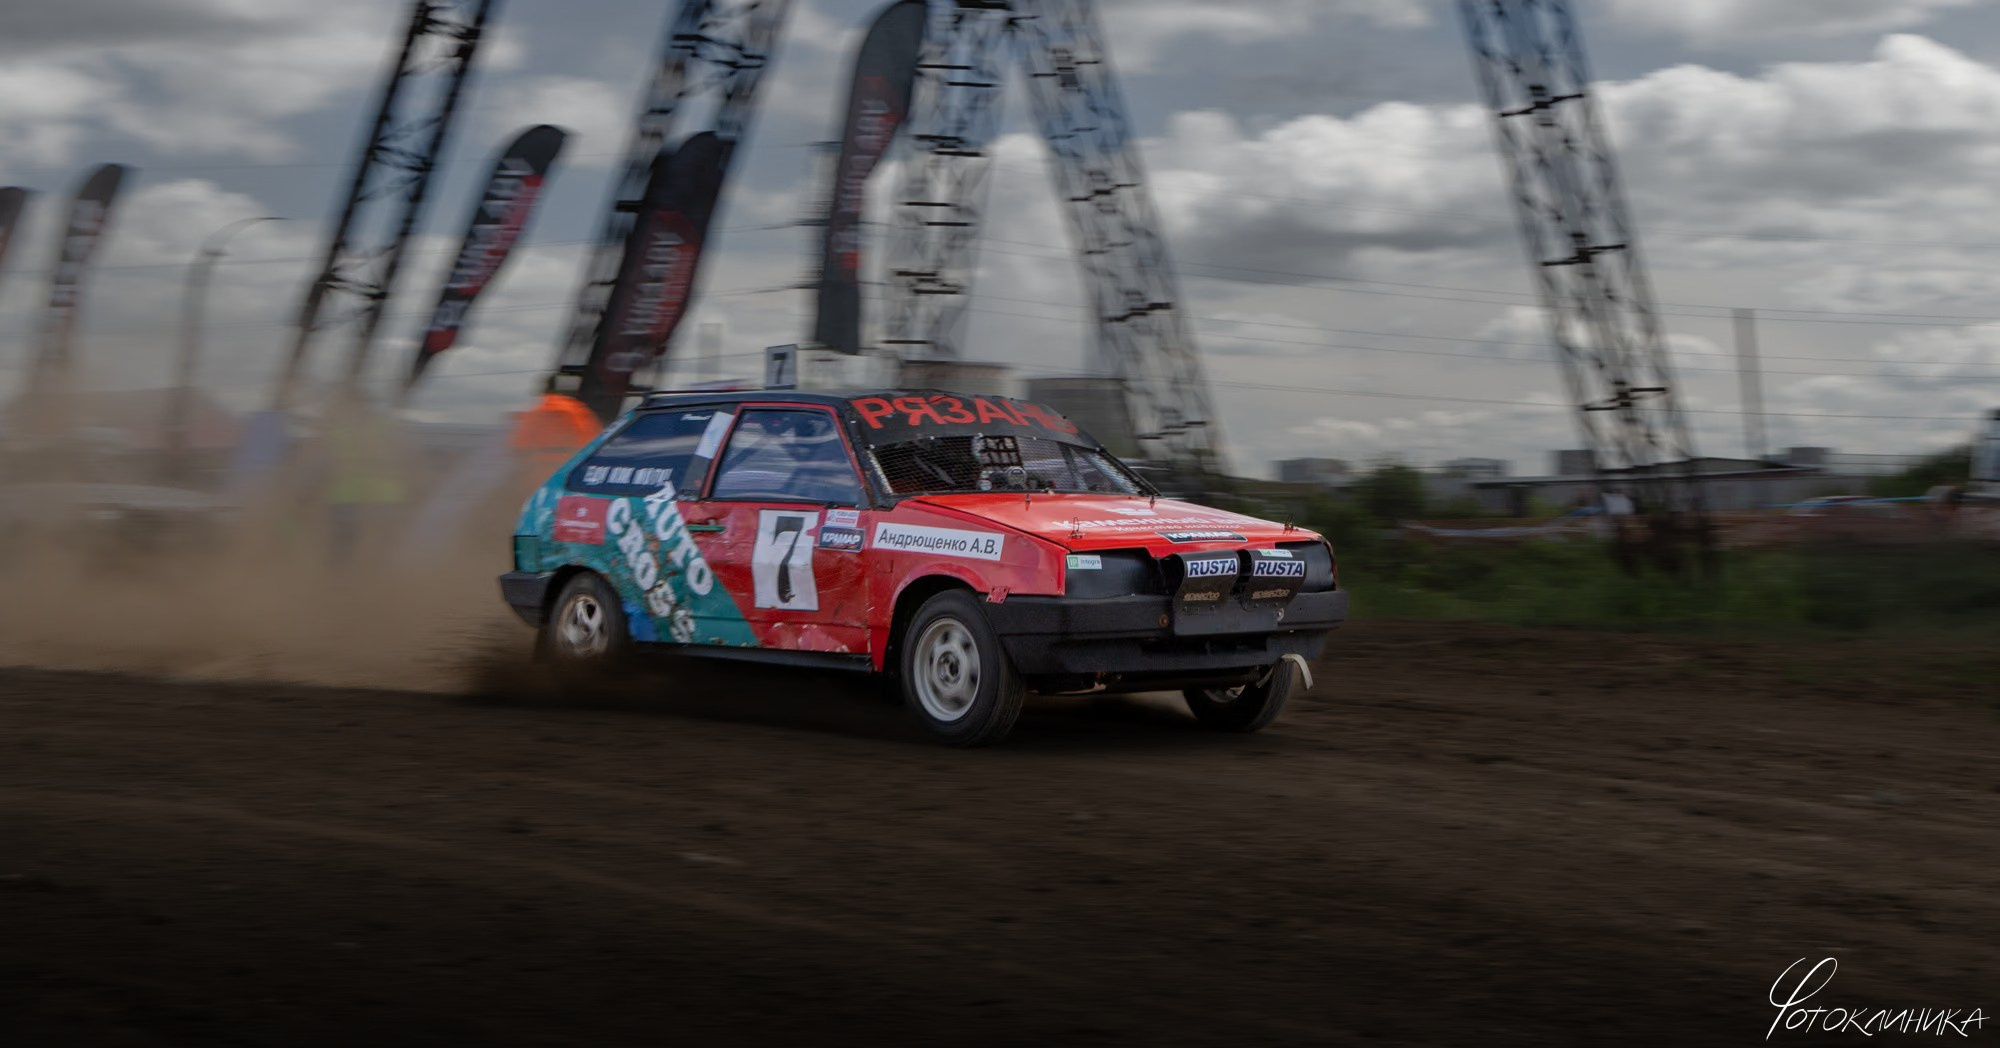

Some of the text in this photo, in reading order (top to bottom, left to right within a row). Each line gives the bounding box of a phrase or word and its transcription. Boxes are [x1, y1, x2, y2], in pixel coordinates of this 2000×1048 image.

[772, 353, 788, 385] 7
[851, 395, 1078, 434] РЯЗАНЬ
[879, 528, 998, 555] Андрющенко А.В.
[771, 516, 805, 602] 7
[1189, 559, 1237, 576] RUSTA
[1255, 561, 1303, 576] RUSTA
